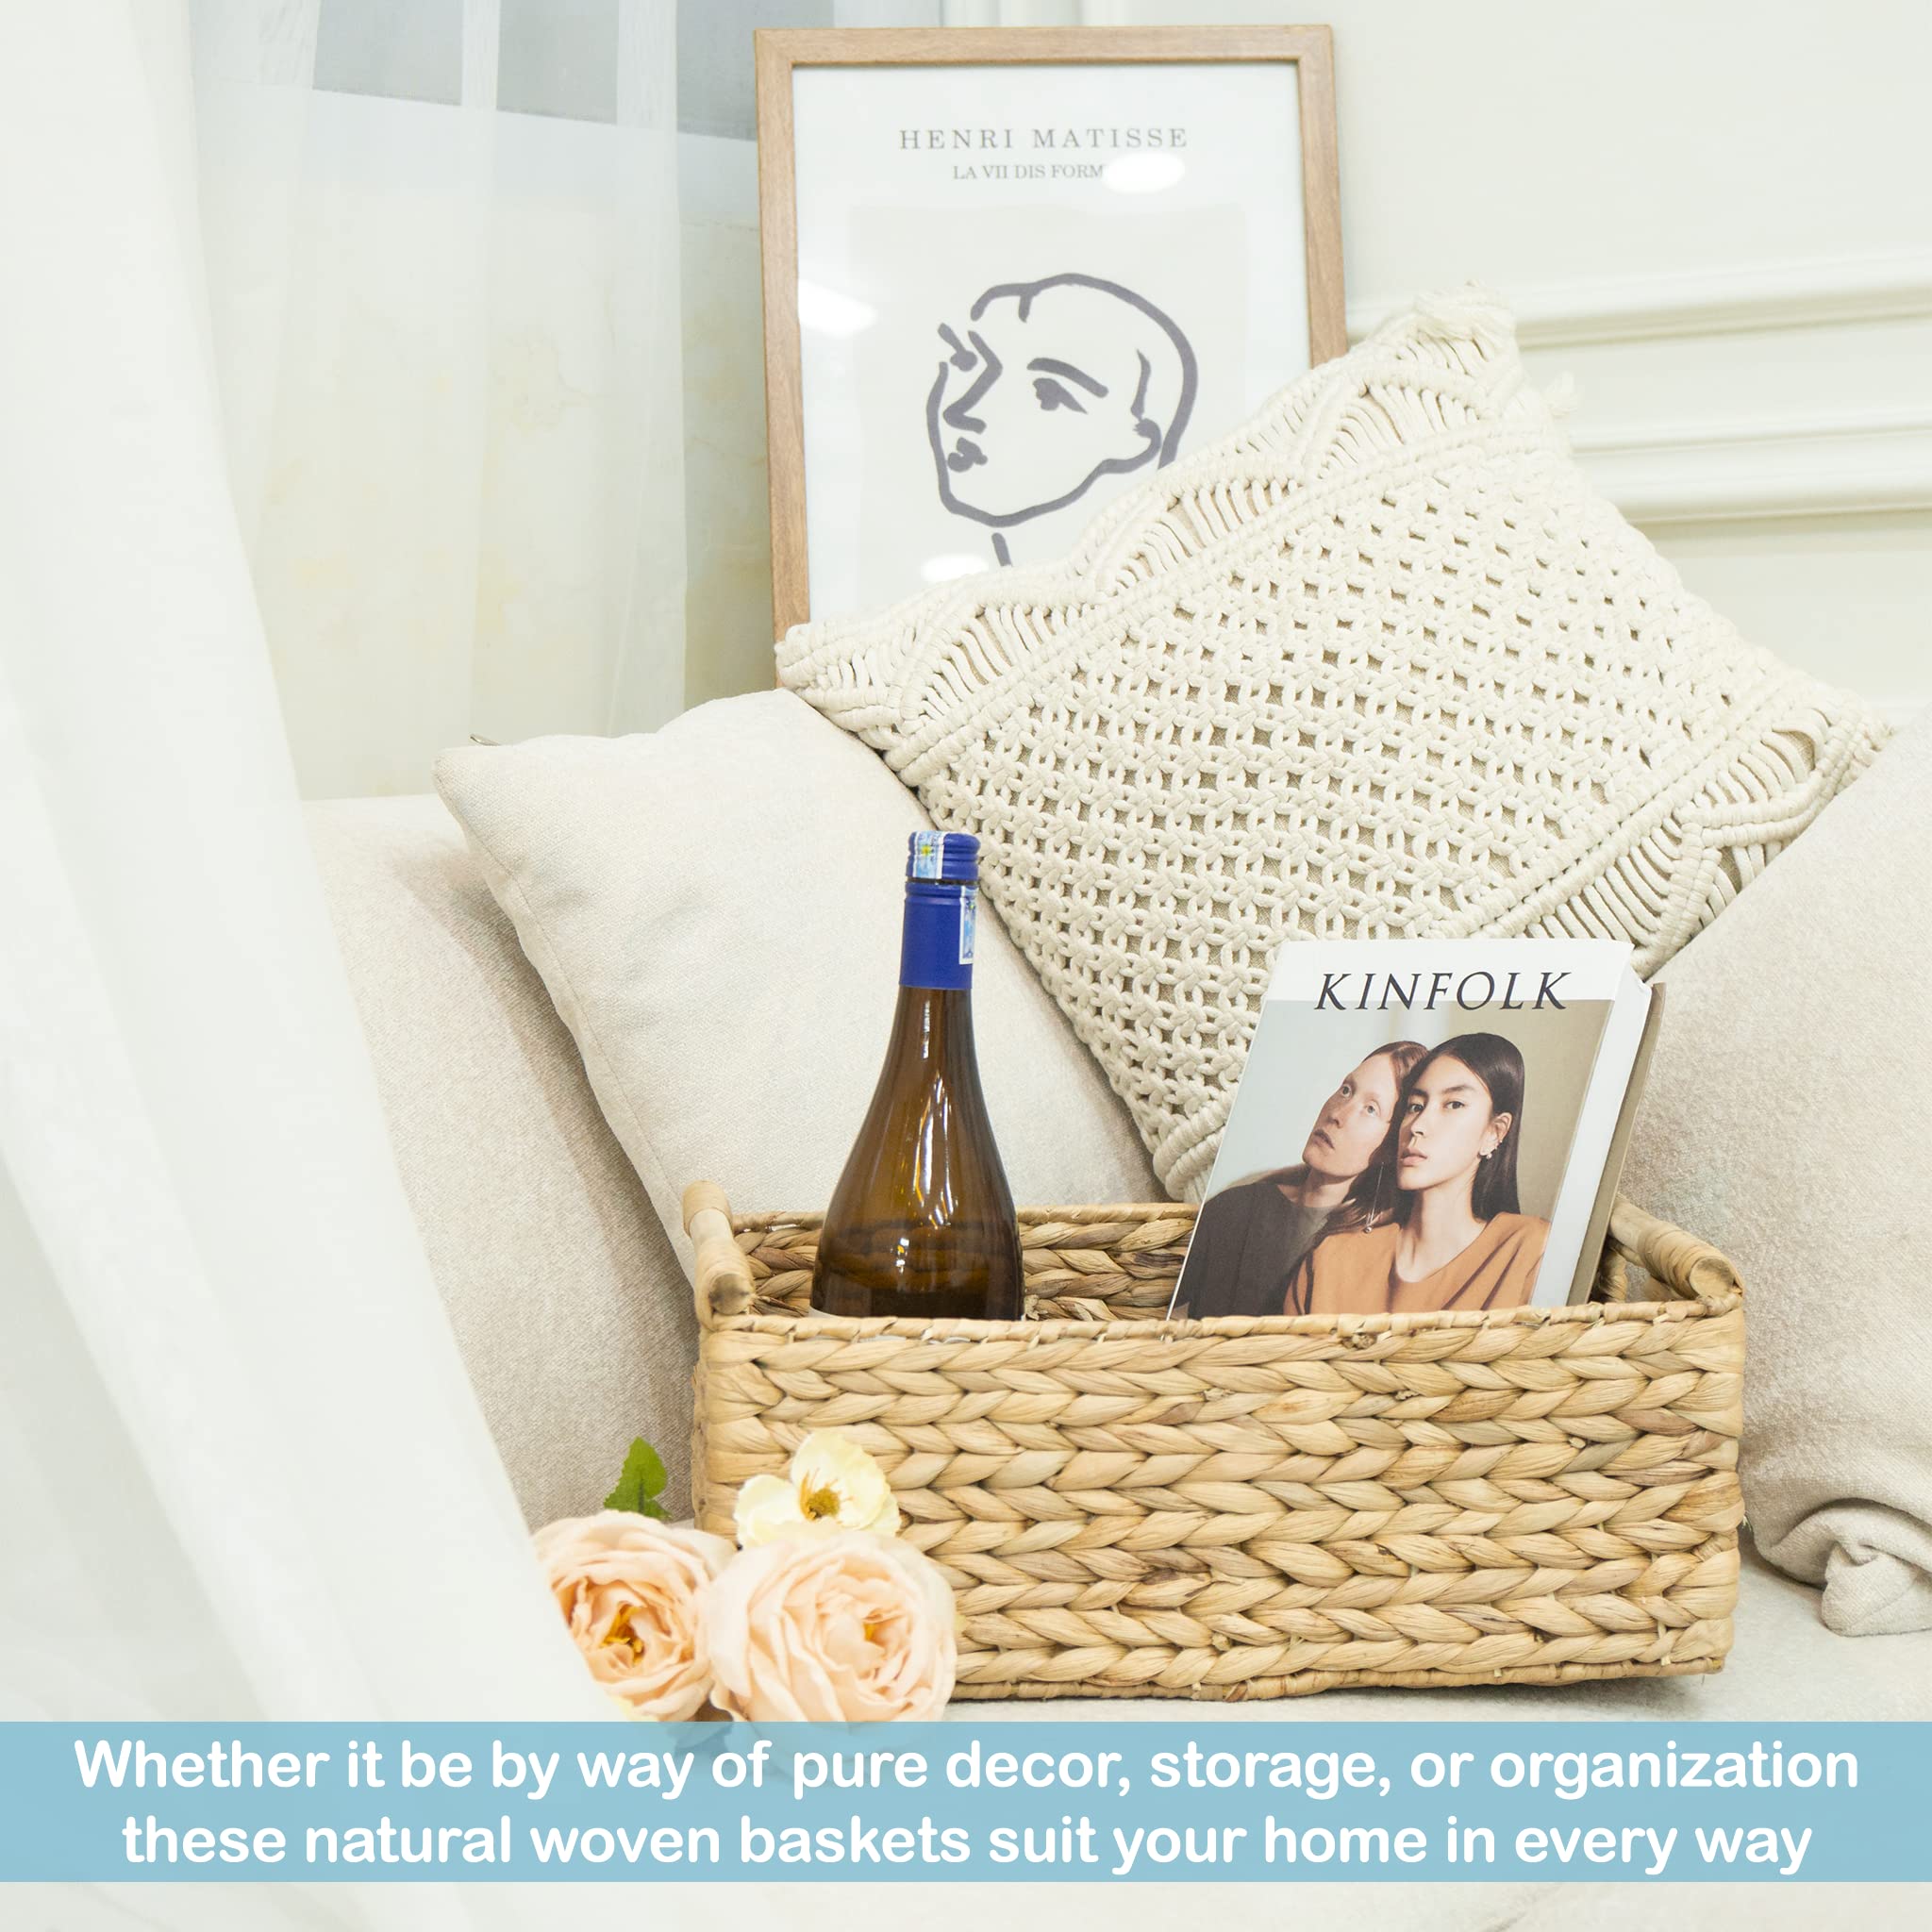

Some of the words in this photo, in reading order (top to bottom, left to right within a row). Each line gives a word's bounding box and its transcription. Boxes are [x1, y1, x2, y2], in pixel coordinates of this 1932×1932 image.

[899, 128, 1012, 150] HENRI
[1033, 127, 1187, 148] MATISSE
[953, 165, 977, 180] LA
[981, 164, 1008, 179] VII
[1014, 164, 1046, 179] DIS
[1051, 163, 1106, 178] FORM
[1313, 971, 1572, 1011] KINFOLK
